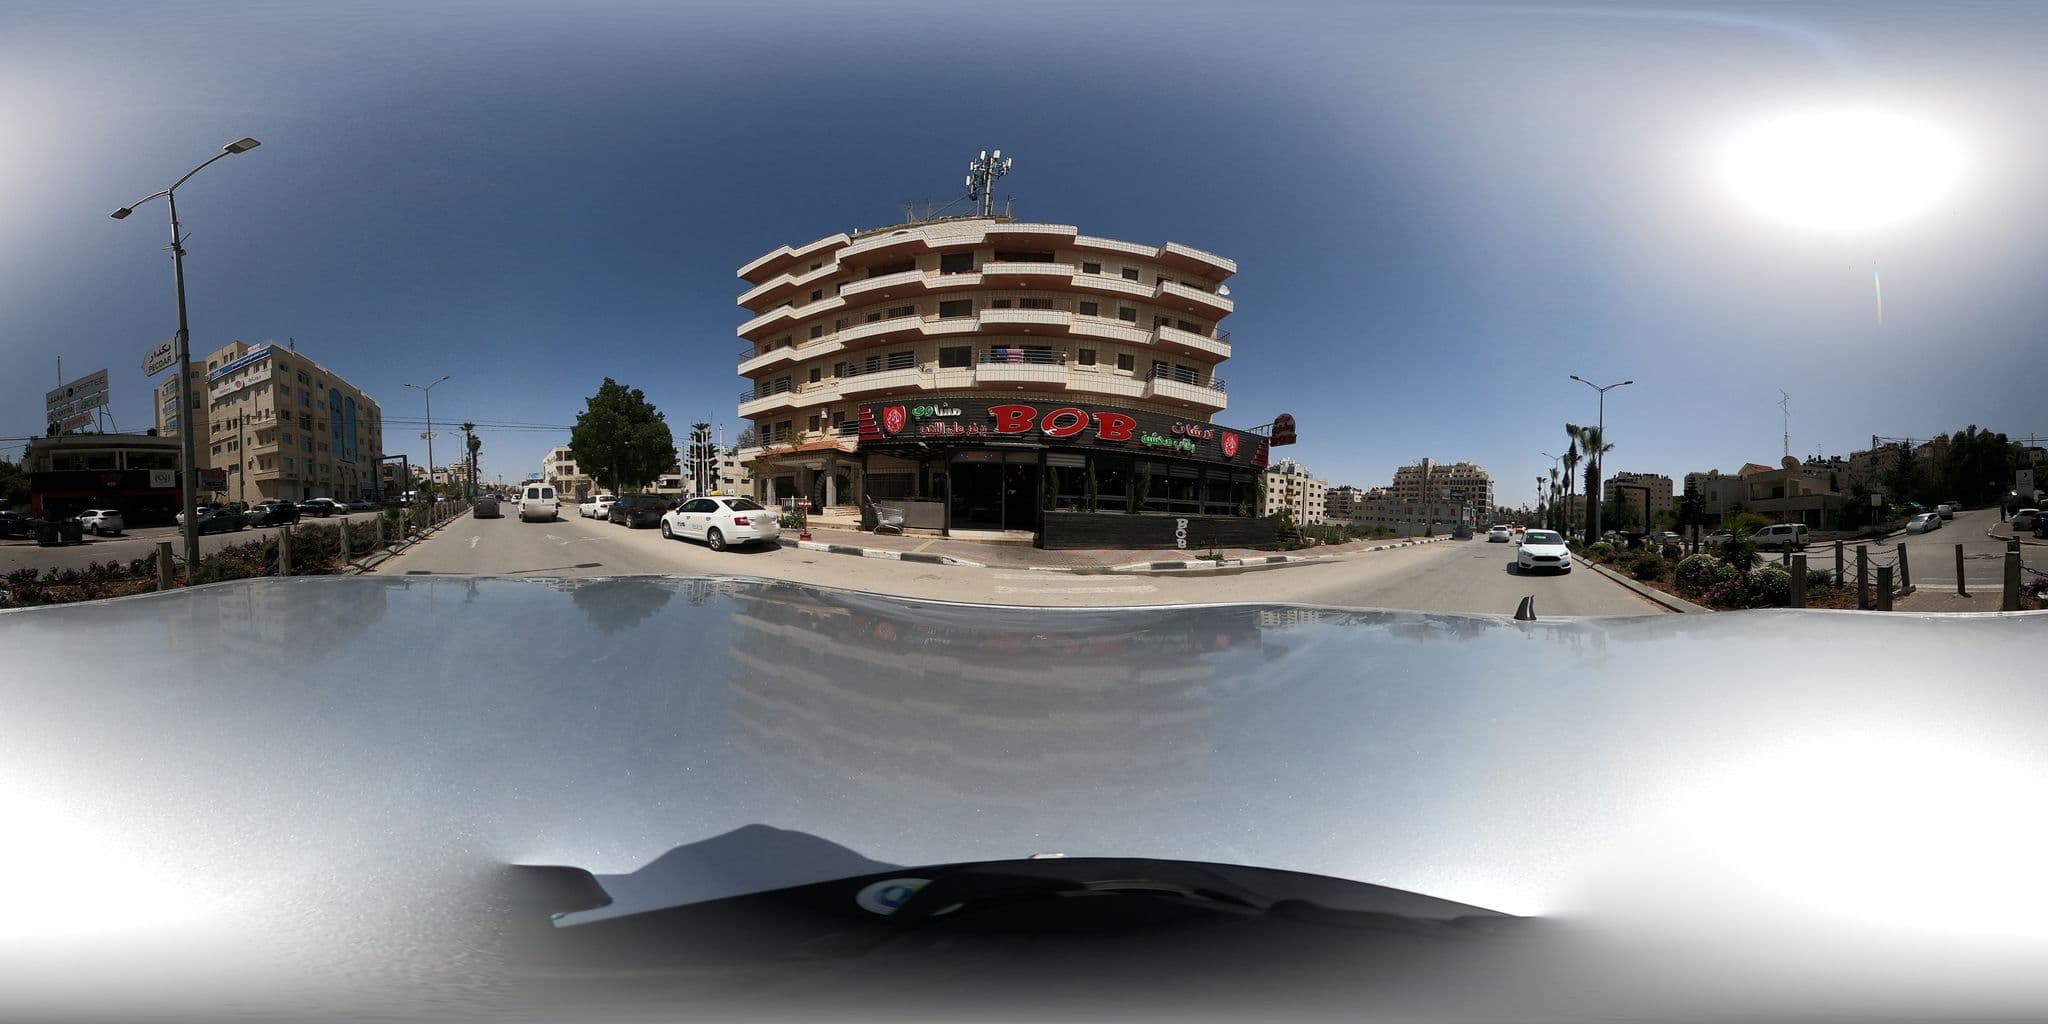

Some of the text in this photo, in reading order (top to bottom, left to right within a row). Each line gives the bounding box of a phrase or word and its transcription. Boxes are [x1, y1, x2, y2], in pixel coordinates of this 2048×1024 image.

[149, 355, 171, 373] PECDAR
[912, 402, 961, 420] مشاوي
[987, 404, 1137, 441] BOB
[1175, 518, 1189, 548] BOB
